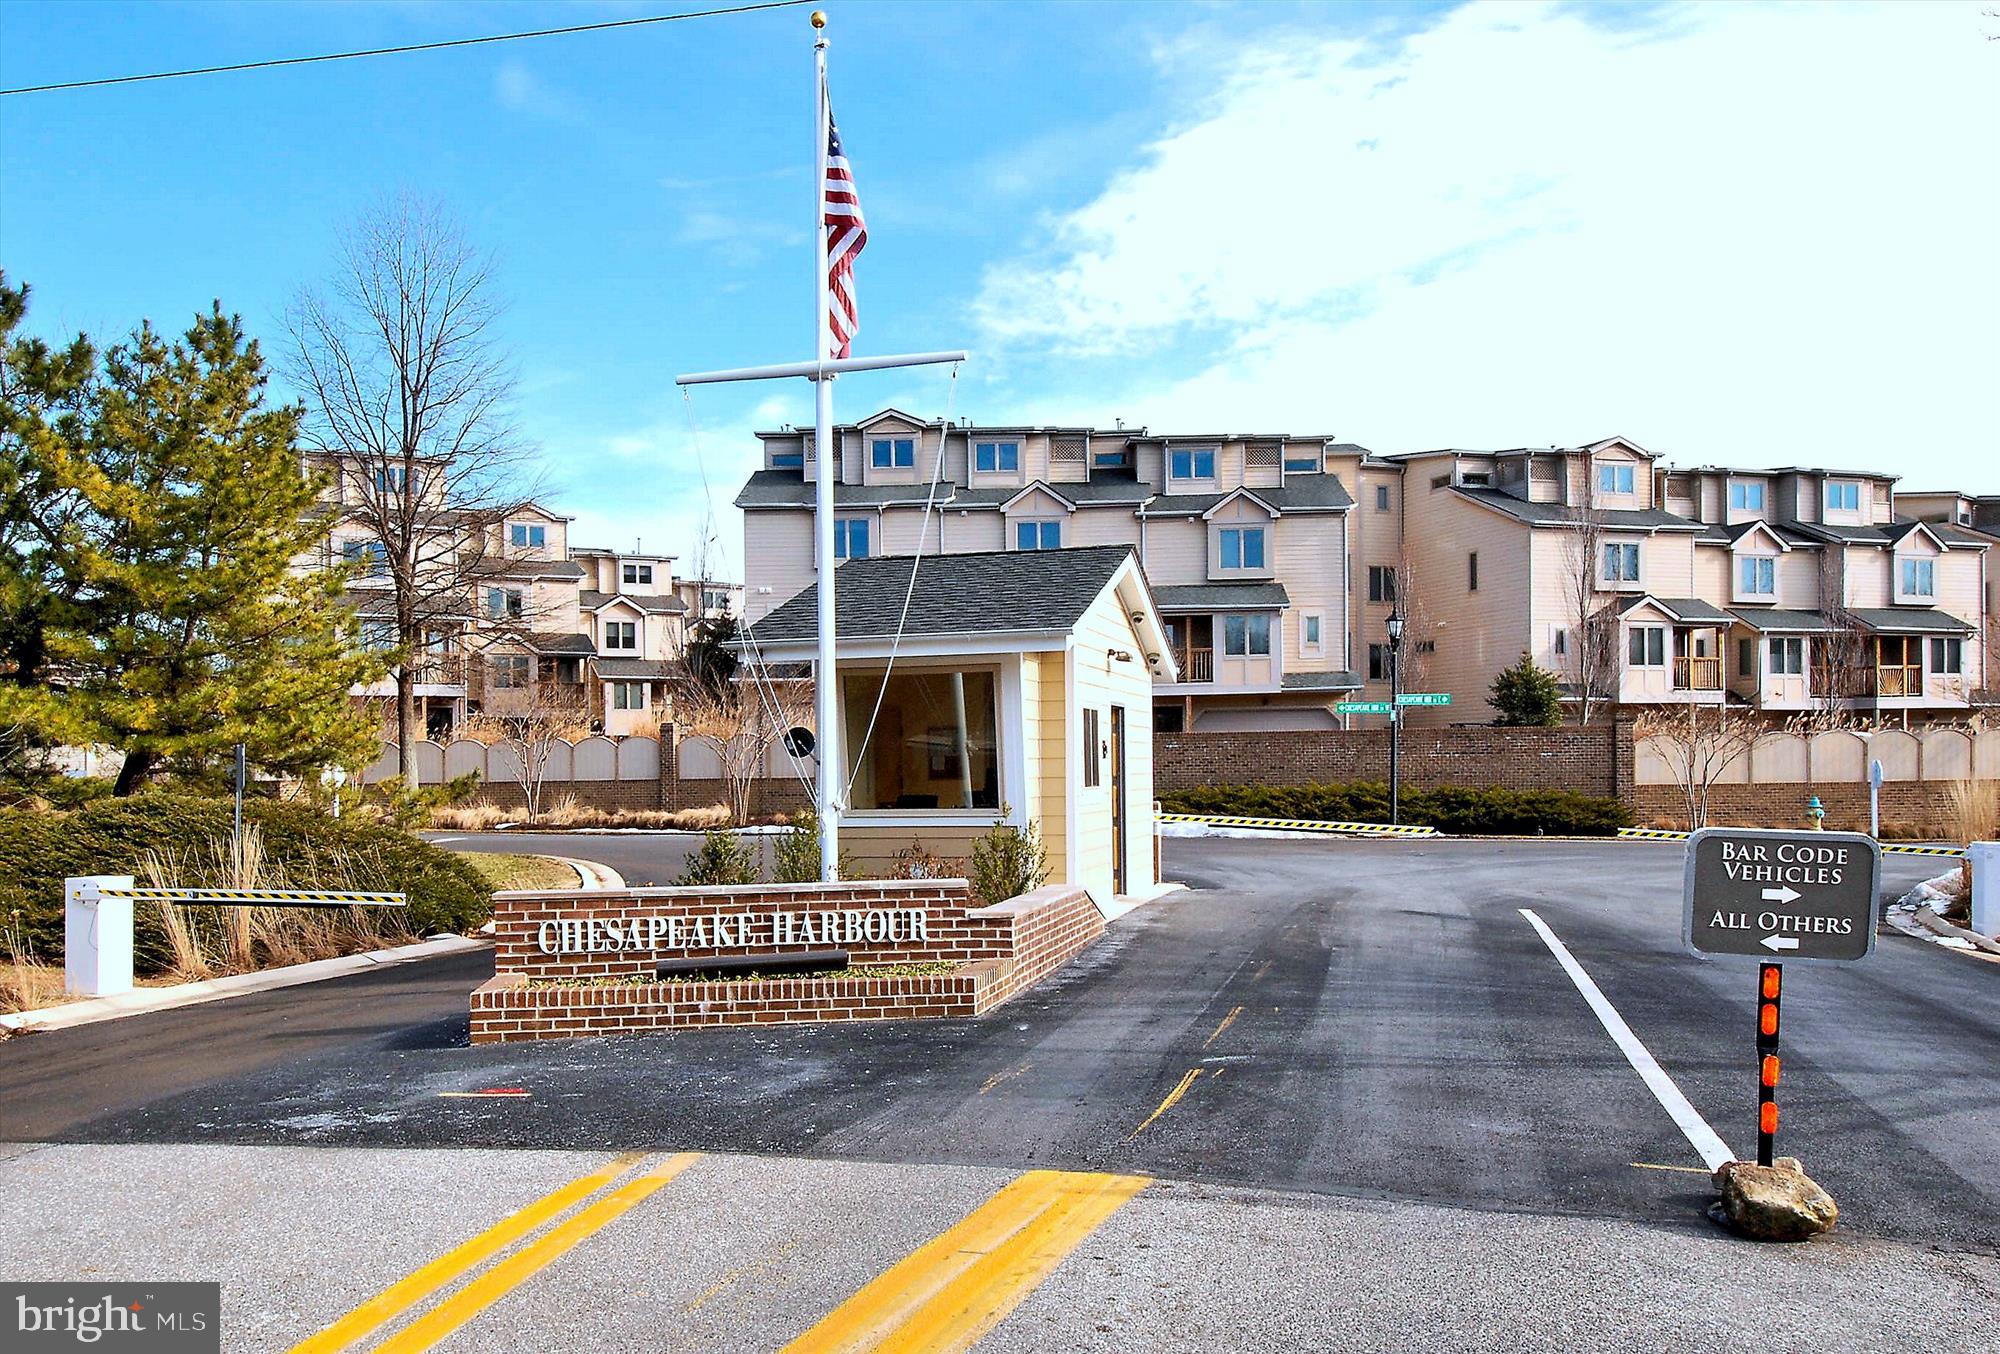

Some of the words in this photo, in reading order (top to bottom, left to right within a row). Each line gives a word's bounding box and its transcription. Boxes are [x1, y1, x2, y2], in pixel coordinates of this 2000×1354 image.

[1721, 841, 1769, 862] BAR
[1777, 844, 1849, 865] CODE
[1723, 861, 1843, 885] VEHICLES
[537, 912, 755, 955] CHESAPEAKE
[771, 908, 929, 945] HARBOUR
[1708, 909, 1751, 930] ALL
[1757, 911, 1852, 935] OTHERS
